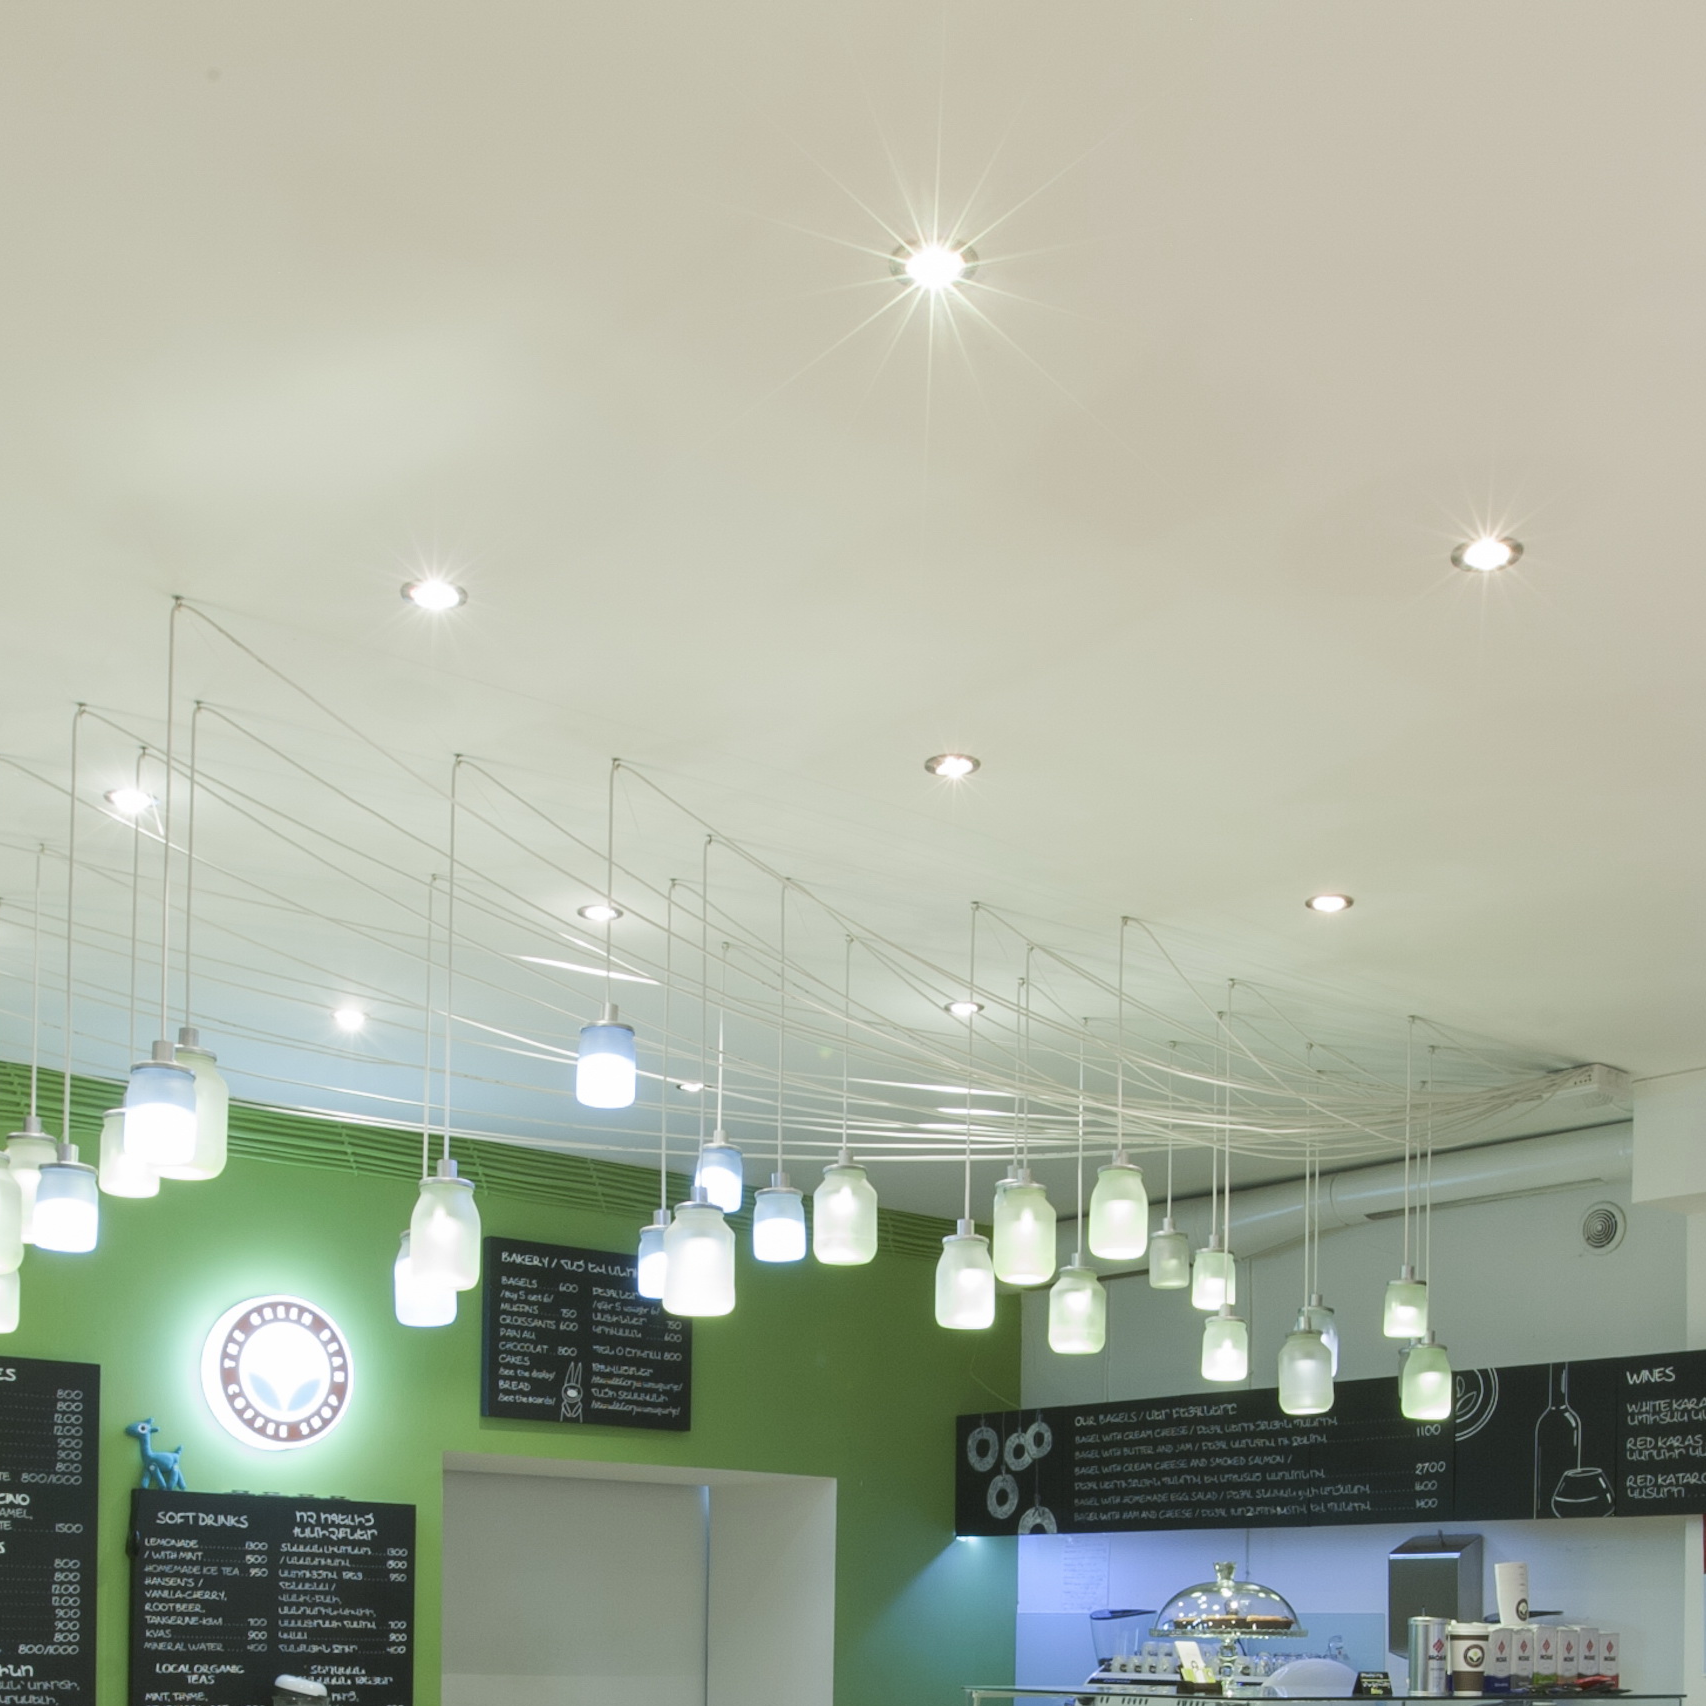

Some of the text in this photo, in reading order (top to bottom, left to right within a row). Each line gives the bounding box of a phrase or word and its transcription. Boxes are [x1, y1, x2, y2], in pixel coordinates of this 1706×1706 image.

[501, 1251, 550, 1268] BAKERY
[501, 1276, 578, 1293] BAGELS 600
[500, 1303, 577, 1318] MUFFINS 750
[499, 1315, 578, 1331] CROISSANTS 600
[499, 1328, 520, 1338] PAIN
[664, 1333, 682, 1343] 600
[499, 1342, 549, 1354] CHOCOLAT
[499, 1354, 530, 1366] CAKES
[1626, 1366, 1675, 1384] WINES
[498, 1379, 531, 1391] BREAD
[56, 1389, 83, 1400] 800
[56, 1402, 83, 1411] 800
[1627, 1400, 1671, 1413] WHITE
[54, 1414, 83, 1424] 1200
[1074, 1416, 1097, 1427] OUR
[1099, 1411, 1137, 1424] BAGELS
[53, 1426, 83, 1436] 1200
[1102, 1432, 1122, 1442] WITH
[1123, 1429, 1153, 1440] CREAM
[1154, 1426, 1188, 1438] CHEESE
[1416, 1424, 1441, 1437] 1100
[57, 1439, 83, 1449] 900
[1626, 1436, 1655, 1449] RED
[1658, 1434, 1703, 1448] KARAS
[57, 1451, 82, 1460] 900
[55, 1463, 82, 1473] 800
[1415, 1461, 1446, 1475] 2700
[21, 1473, 82, 1485] 800/1000
[1626, 1474, 1655, 1487] RED
[156, 1511, 249, 1528] SOFT DRINKS
[55, 1523, 83, 1533] 1500
[144, 1537, 199, 1549] LEMONADE
[151, 1551, 203, 1561] WITH MINT
[54, 1558, 80, 1569] 800
[144, 1564, 268, 1577] HOMEMADE ICE TEA 950
[54, 1572, 80, 1582] 800
[52, 1584, 80, 1594] 1200
[52, 1596, 80, 1606] 1200
[55, 1608, 80, 1618] 900
[54, 1621, 80, 1630] 900
[247, 1618, 267, 1627] 700
[53, 1632, 80, 1642] 800
[145, 1629, 267, 1640] KVAS 900
[18, 1644, 79, 1655] 800/1000
[143, 1641, 268, 1652] MINERAL WATER 400
[155, 1662, 245, 1674] LOCAL ORGANIC
[186, 1674, 215, 1684] TEAS
